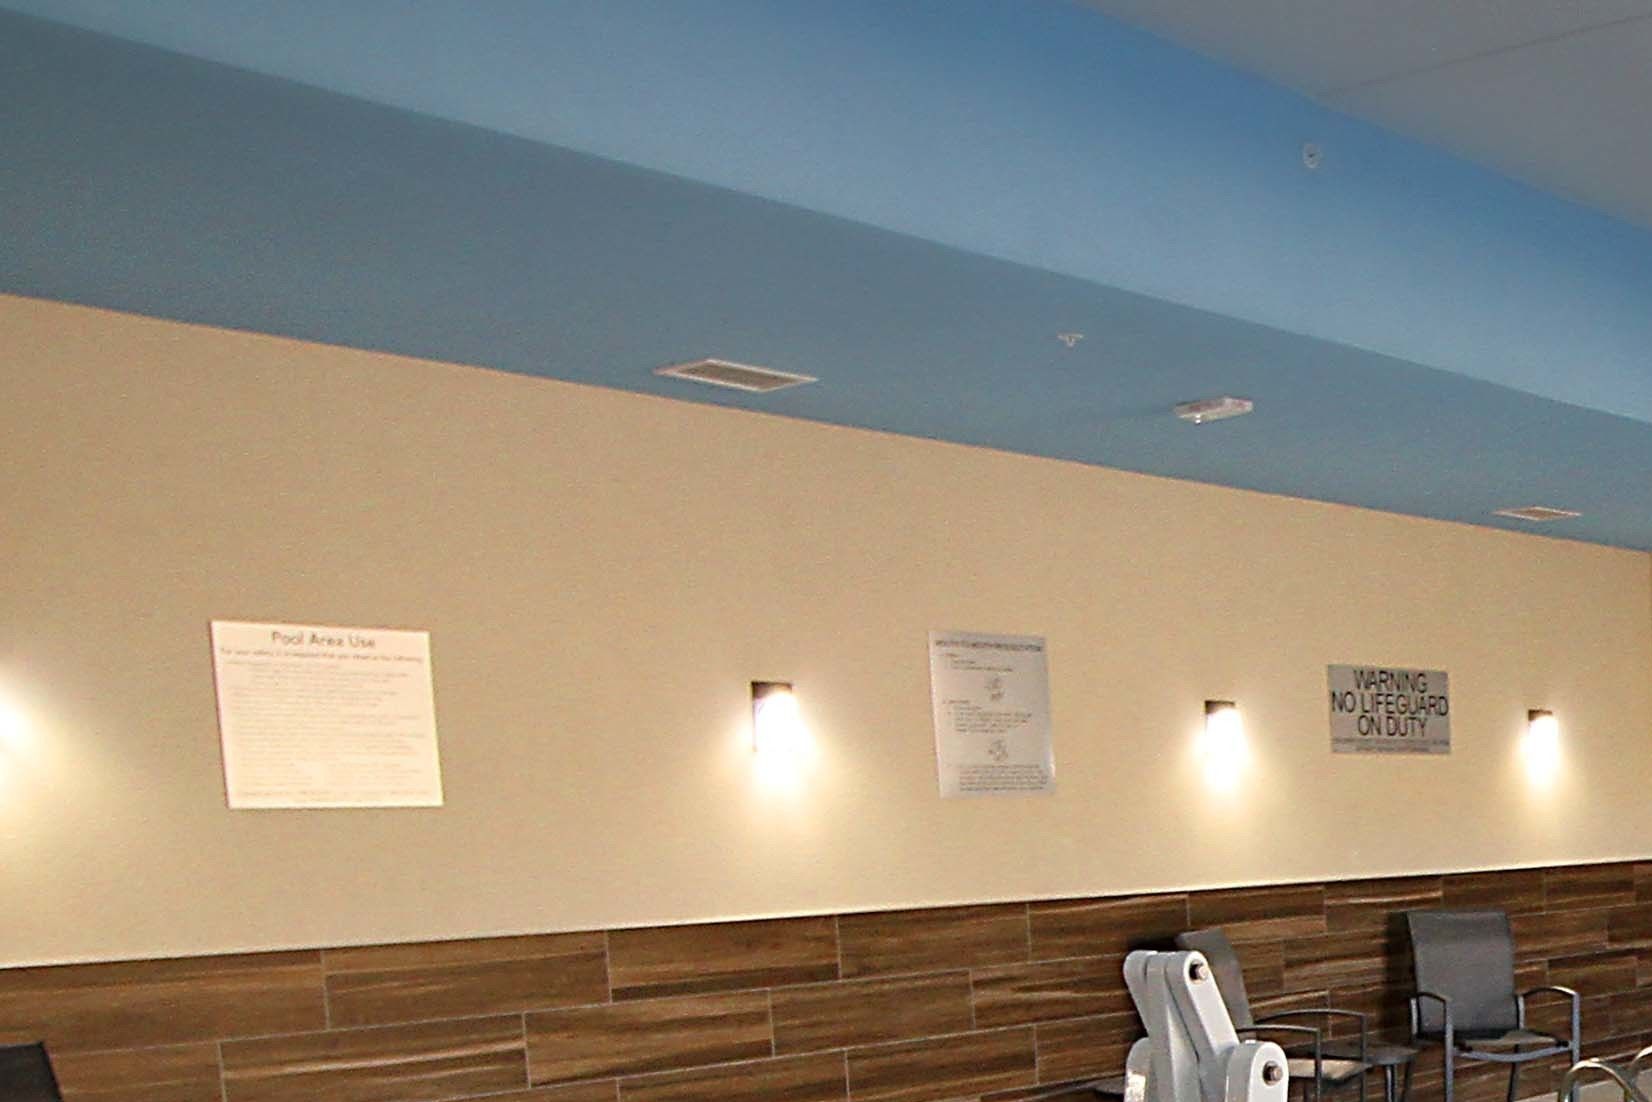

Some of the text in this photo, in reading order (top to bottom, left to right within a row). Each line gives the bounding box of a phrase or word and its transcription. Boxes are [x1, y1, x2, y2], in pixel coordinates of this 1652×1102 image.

[271, 631, 376, 649] Pool Area Use
[1353, 670, 1429, 694] WARNING
[1331, 691, 1450, 717] NO LIFEGUARD
[1357, 715, 1429, 737] ON DUTY
